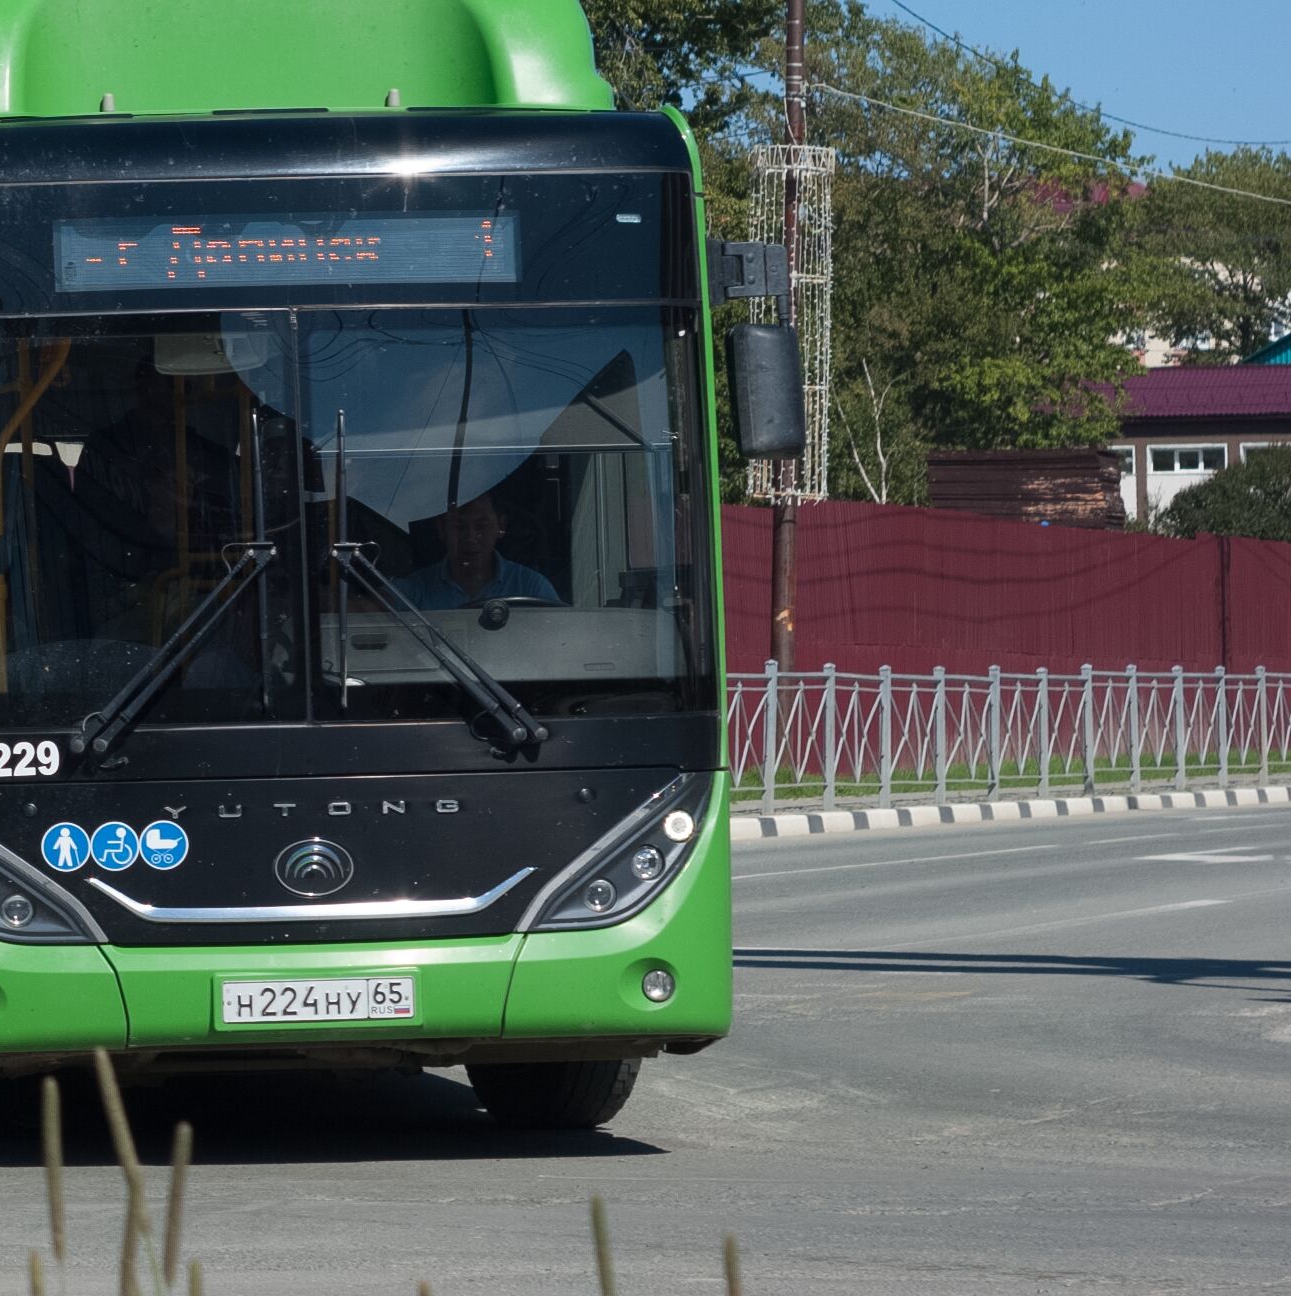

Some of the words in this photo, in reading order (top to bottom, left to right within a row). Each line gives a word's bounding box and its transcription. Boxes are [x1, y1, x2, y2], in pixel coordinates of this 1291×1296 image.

[163, 798, 460, 820] YUTONG
[236, 985, 362, 1018] Н224НУ
[372, 981, 404, 1006] 65
[370, 1005, 394, 1016] RUS
